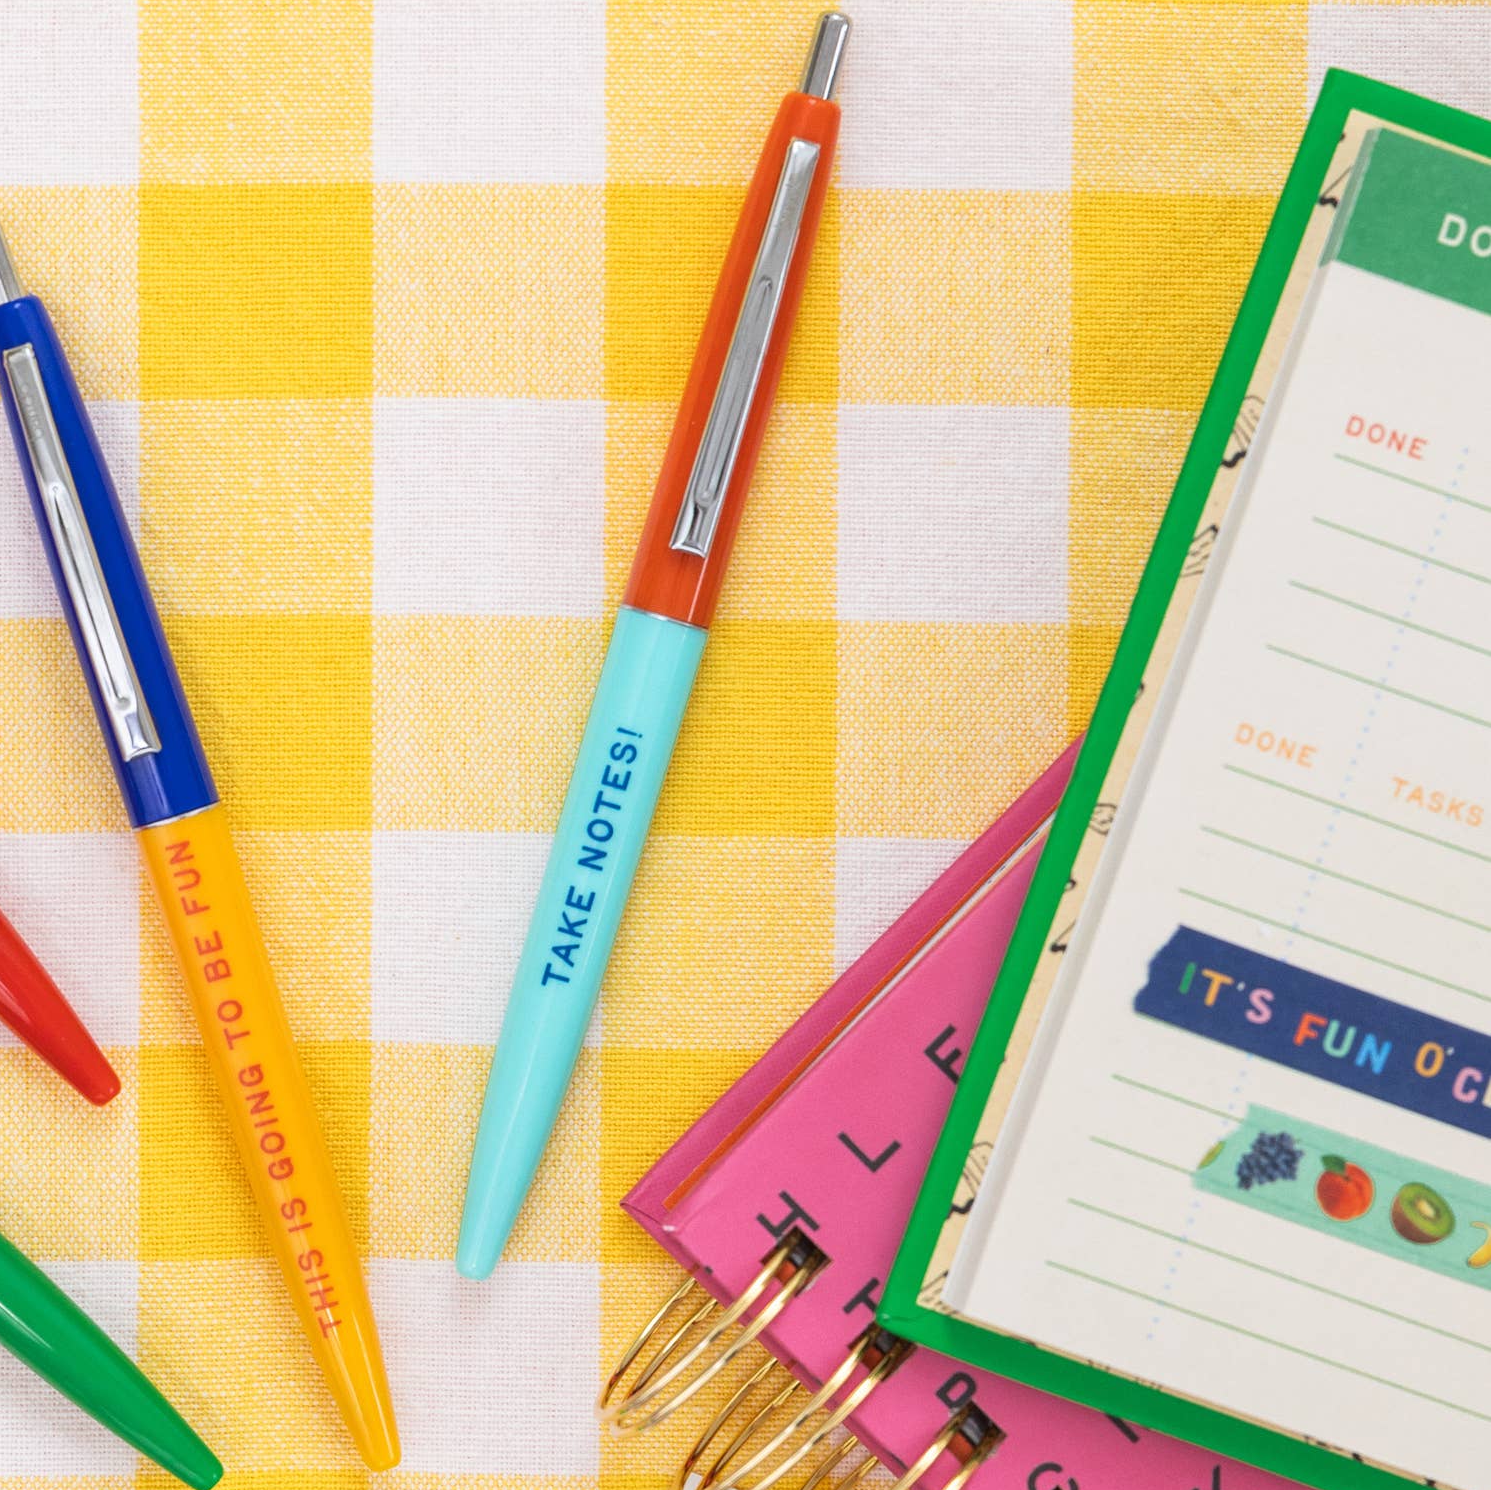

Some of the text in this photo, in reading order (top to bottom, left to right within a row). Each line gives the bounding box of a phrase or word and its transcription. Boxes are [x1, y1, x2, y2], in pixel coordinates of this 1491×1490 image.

[1344, 414, 1428, 461] DONE
[1233, 722, 1485, 828] DONE TASKS
[540, 726, 644, 987] TAKE NOTES!
[1178, 961, 1274, 1025] IT'S
[1294, 1013, 1392, 1075] FUN
[166, 840, 343, 1339] THIS IS GOING TO BE FUN
